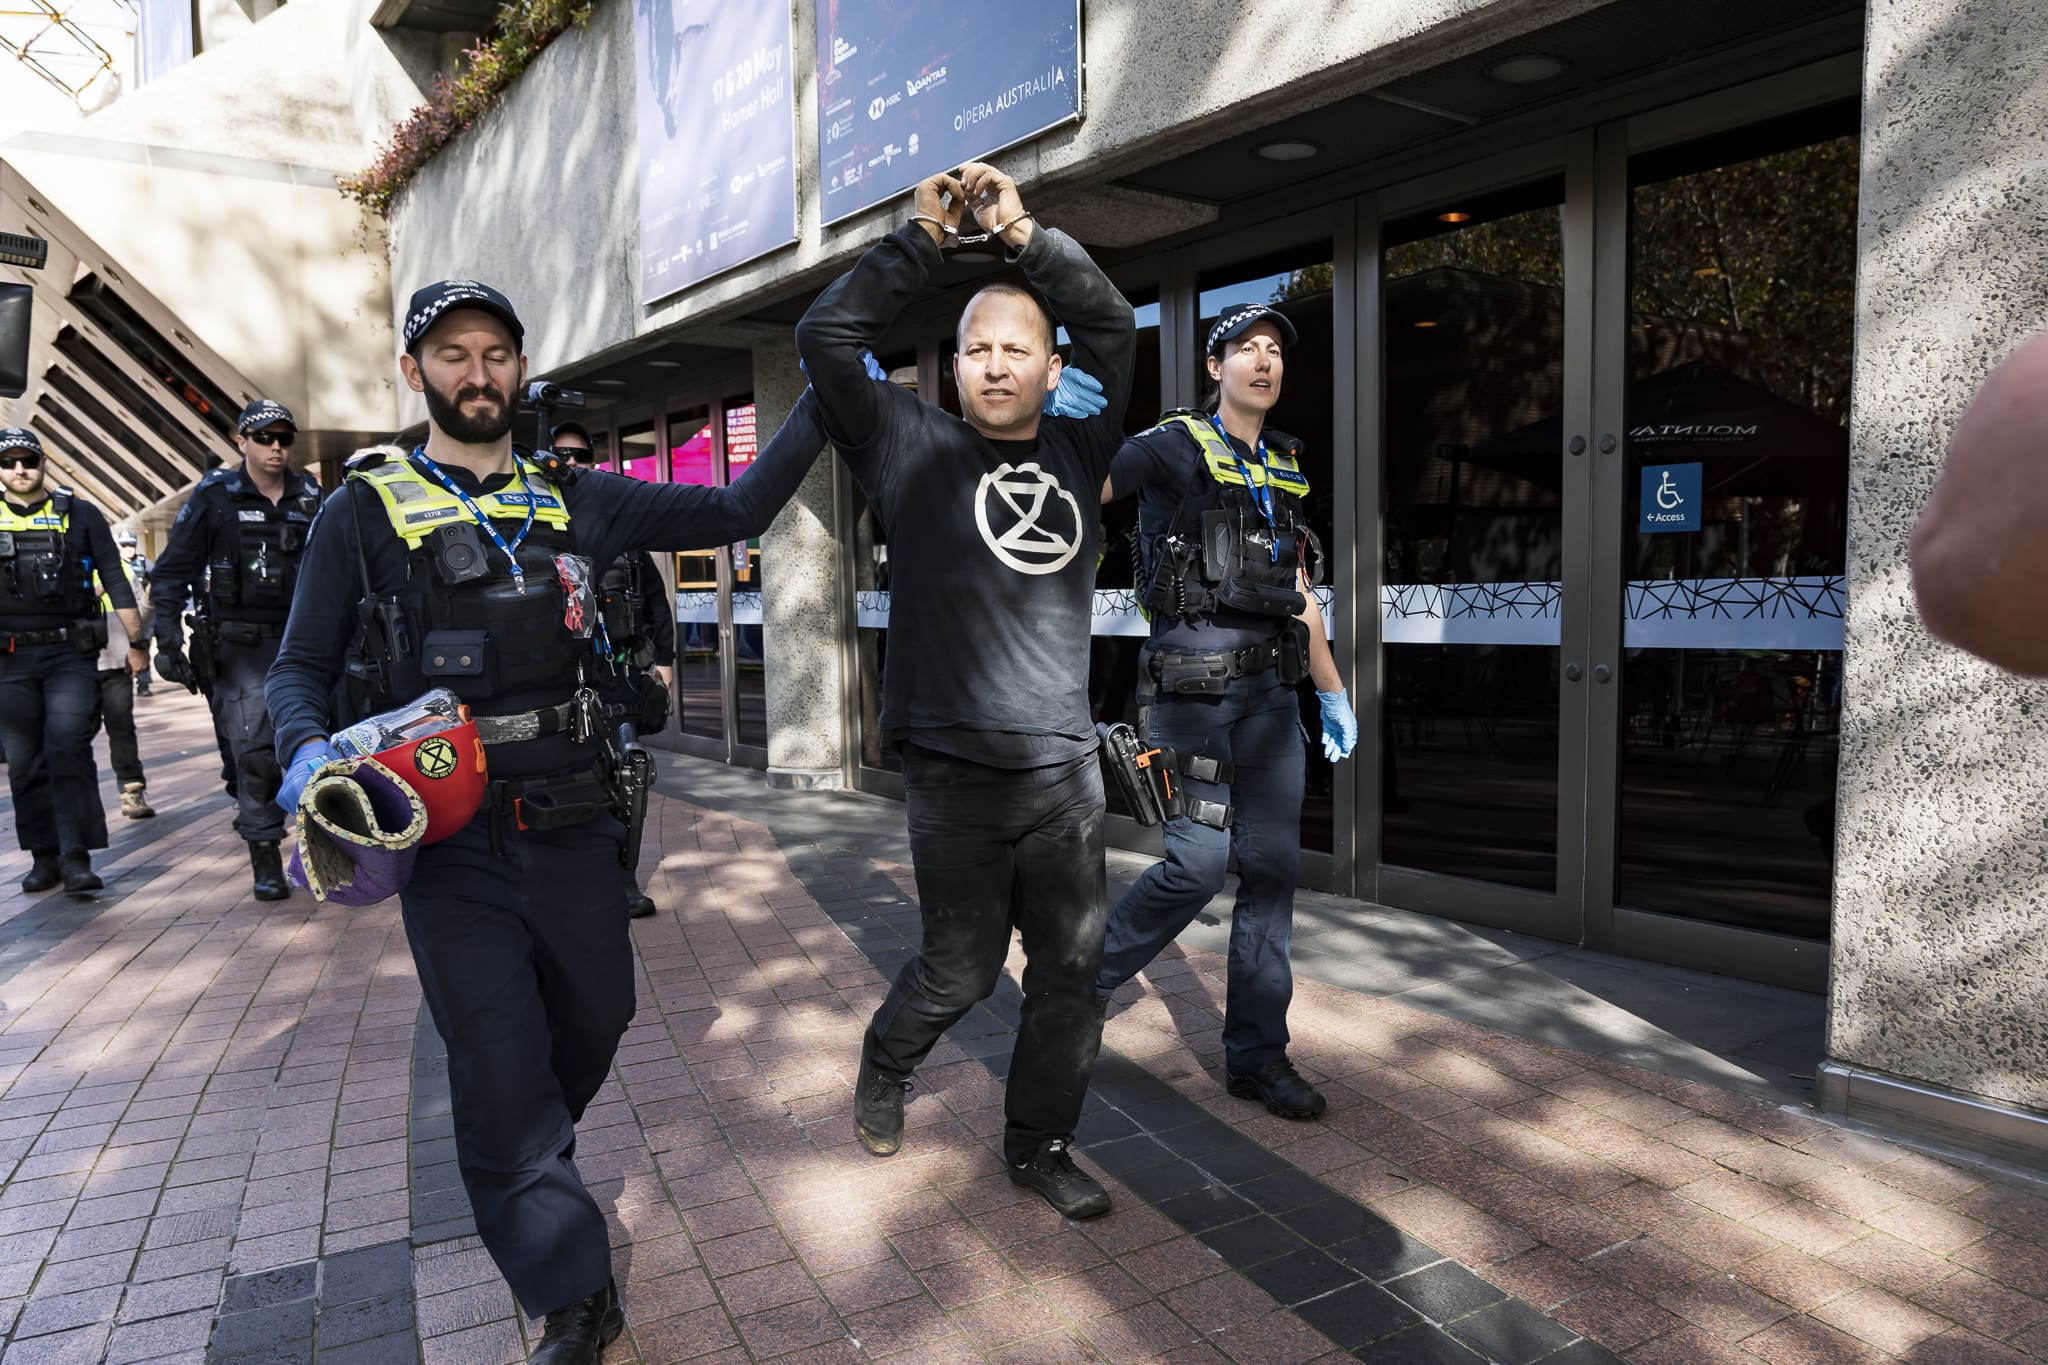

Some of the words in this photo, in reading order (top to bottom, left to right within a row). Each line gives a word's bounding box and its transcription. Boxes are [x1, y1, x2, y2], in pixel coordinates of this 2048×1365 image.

[736, 58, 752, 91] 20
[753, 43, 783, 80] May
[914, 66, 947, 91] QANTAS
[723, 98, 759, 134] Hamer
[761, 74, 784, 111] Hall
[1244, 473, 1255, 489] STAFF
[465, 500, 479, 514] STAFF
[501, 494, 552, 504] Polce
[1655, 512, 1685, 522] Access
[482, 521, 497, 537] STAFF
